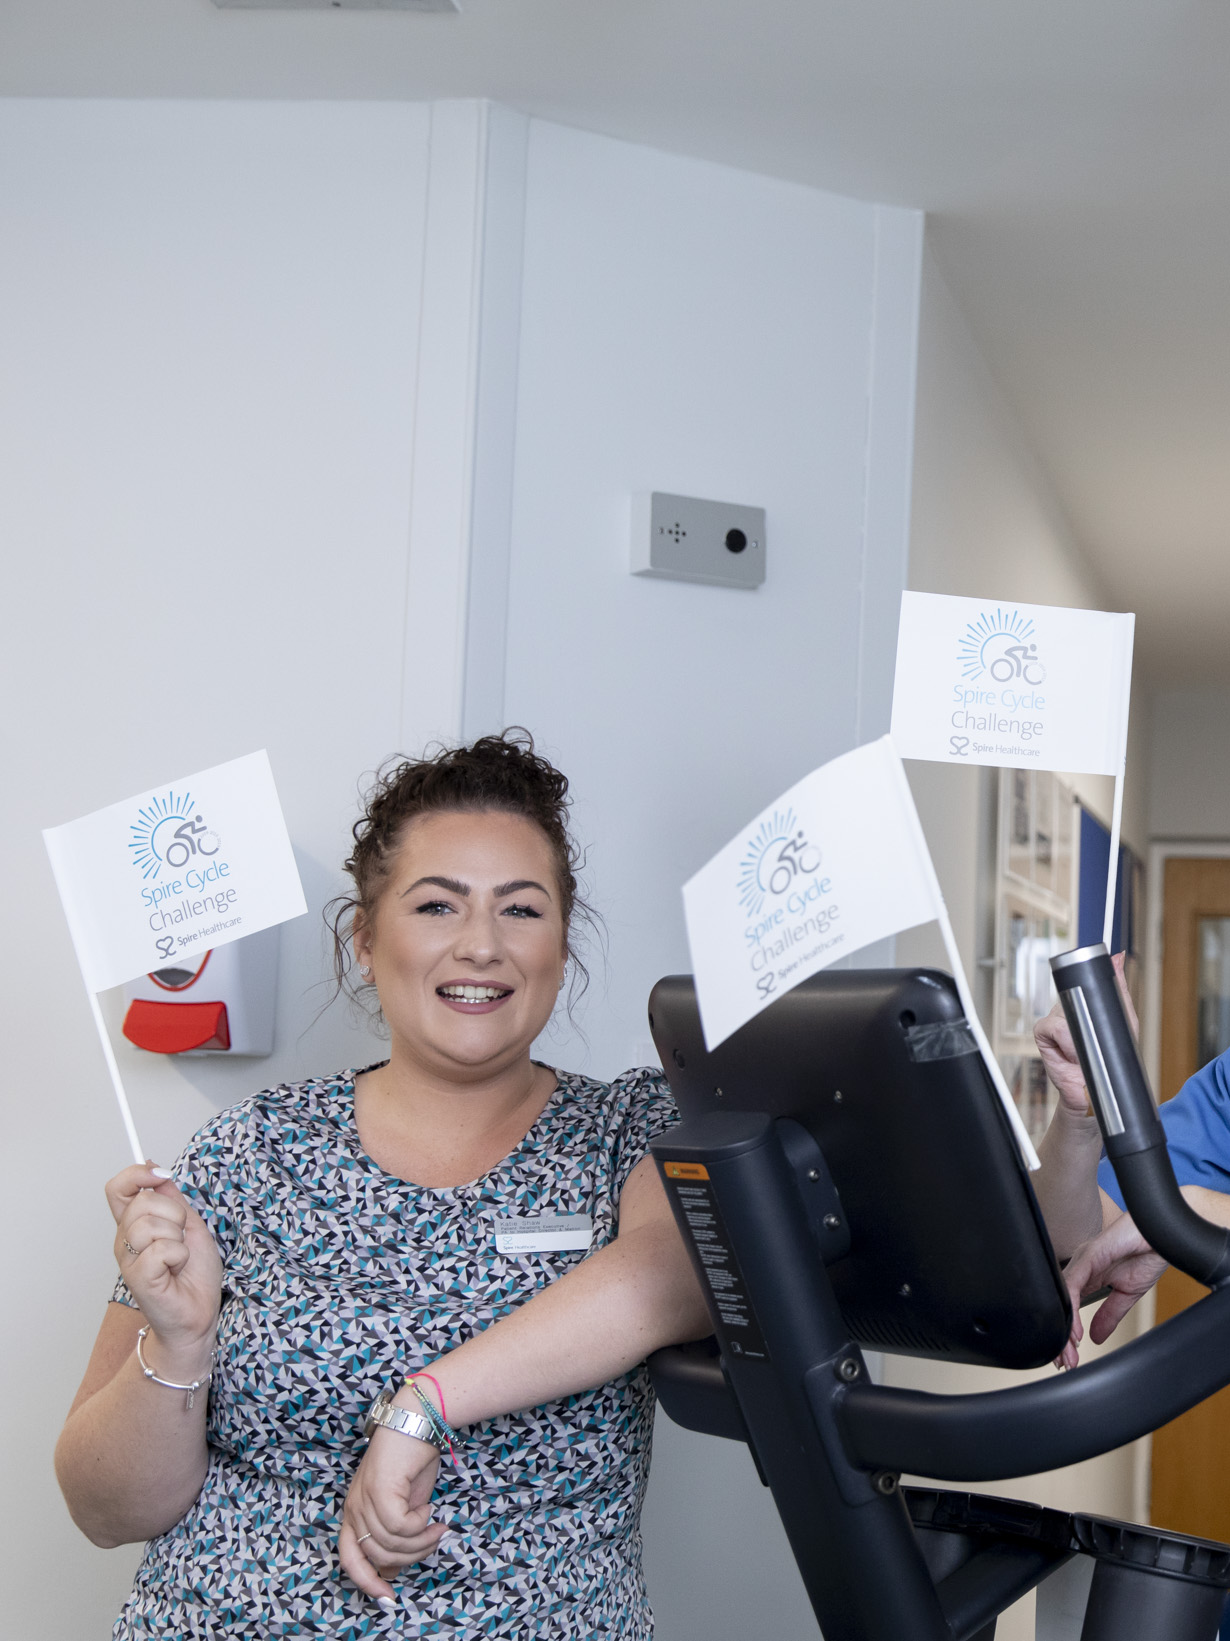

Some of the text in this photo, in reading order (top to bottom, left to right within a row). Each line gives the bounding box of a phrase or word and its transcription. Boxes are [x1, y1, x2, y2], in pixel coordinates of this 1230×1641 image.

[953, 685, 1045, 713] Spire Cycle
[951, 711, 1044, 740] Challenge
[973, 742, 1040, 757] Spire Healthcare
[141, 860, 230, 908] Spire Cycle
[149, 889, 237, 932] Challenge
[744, 877, 832, 949] Spire Cycle
[177, 916, 242, 946] Spire Healthcare
[750, 904, 839, 971] Challenge
